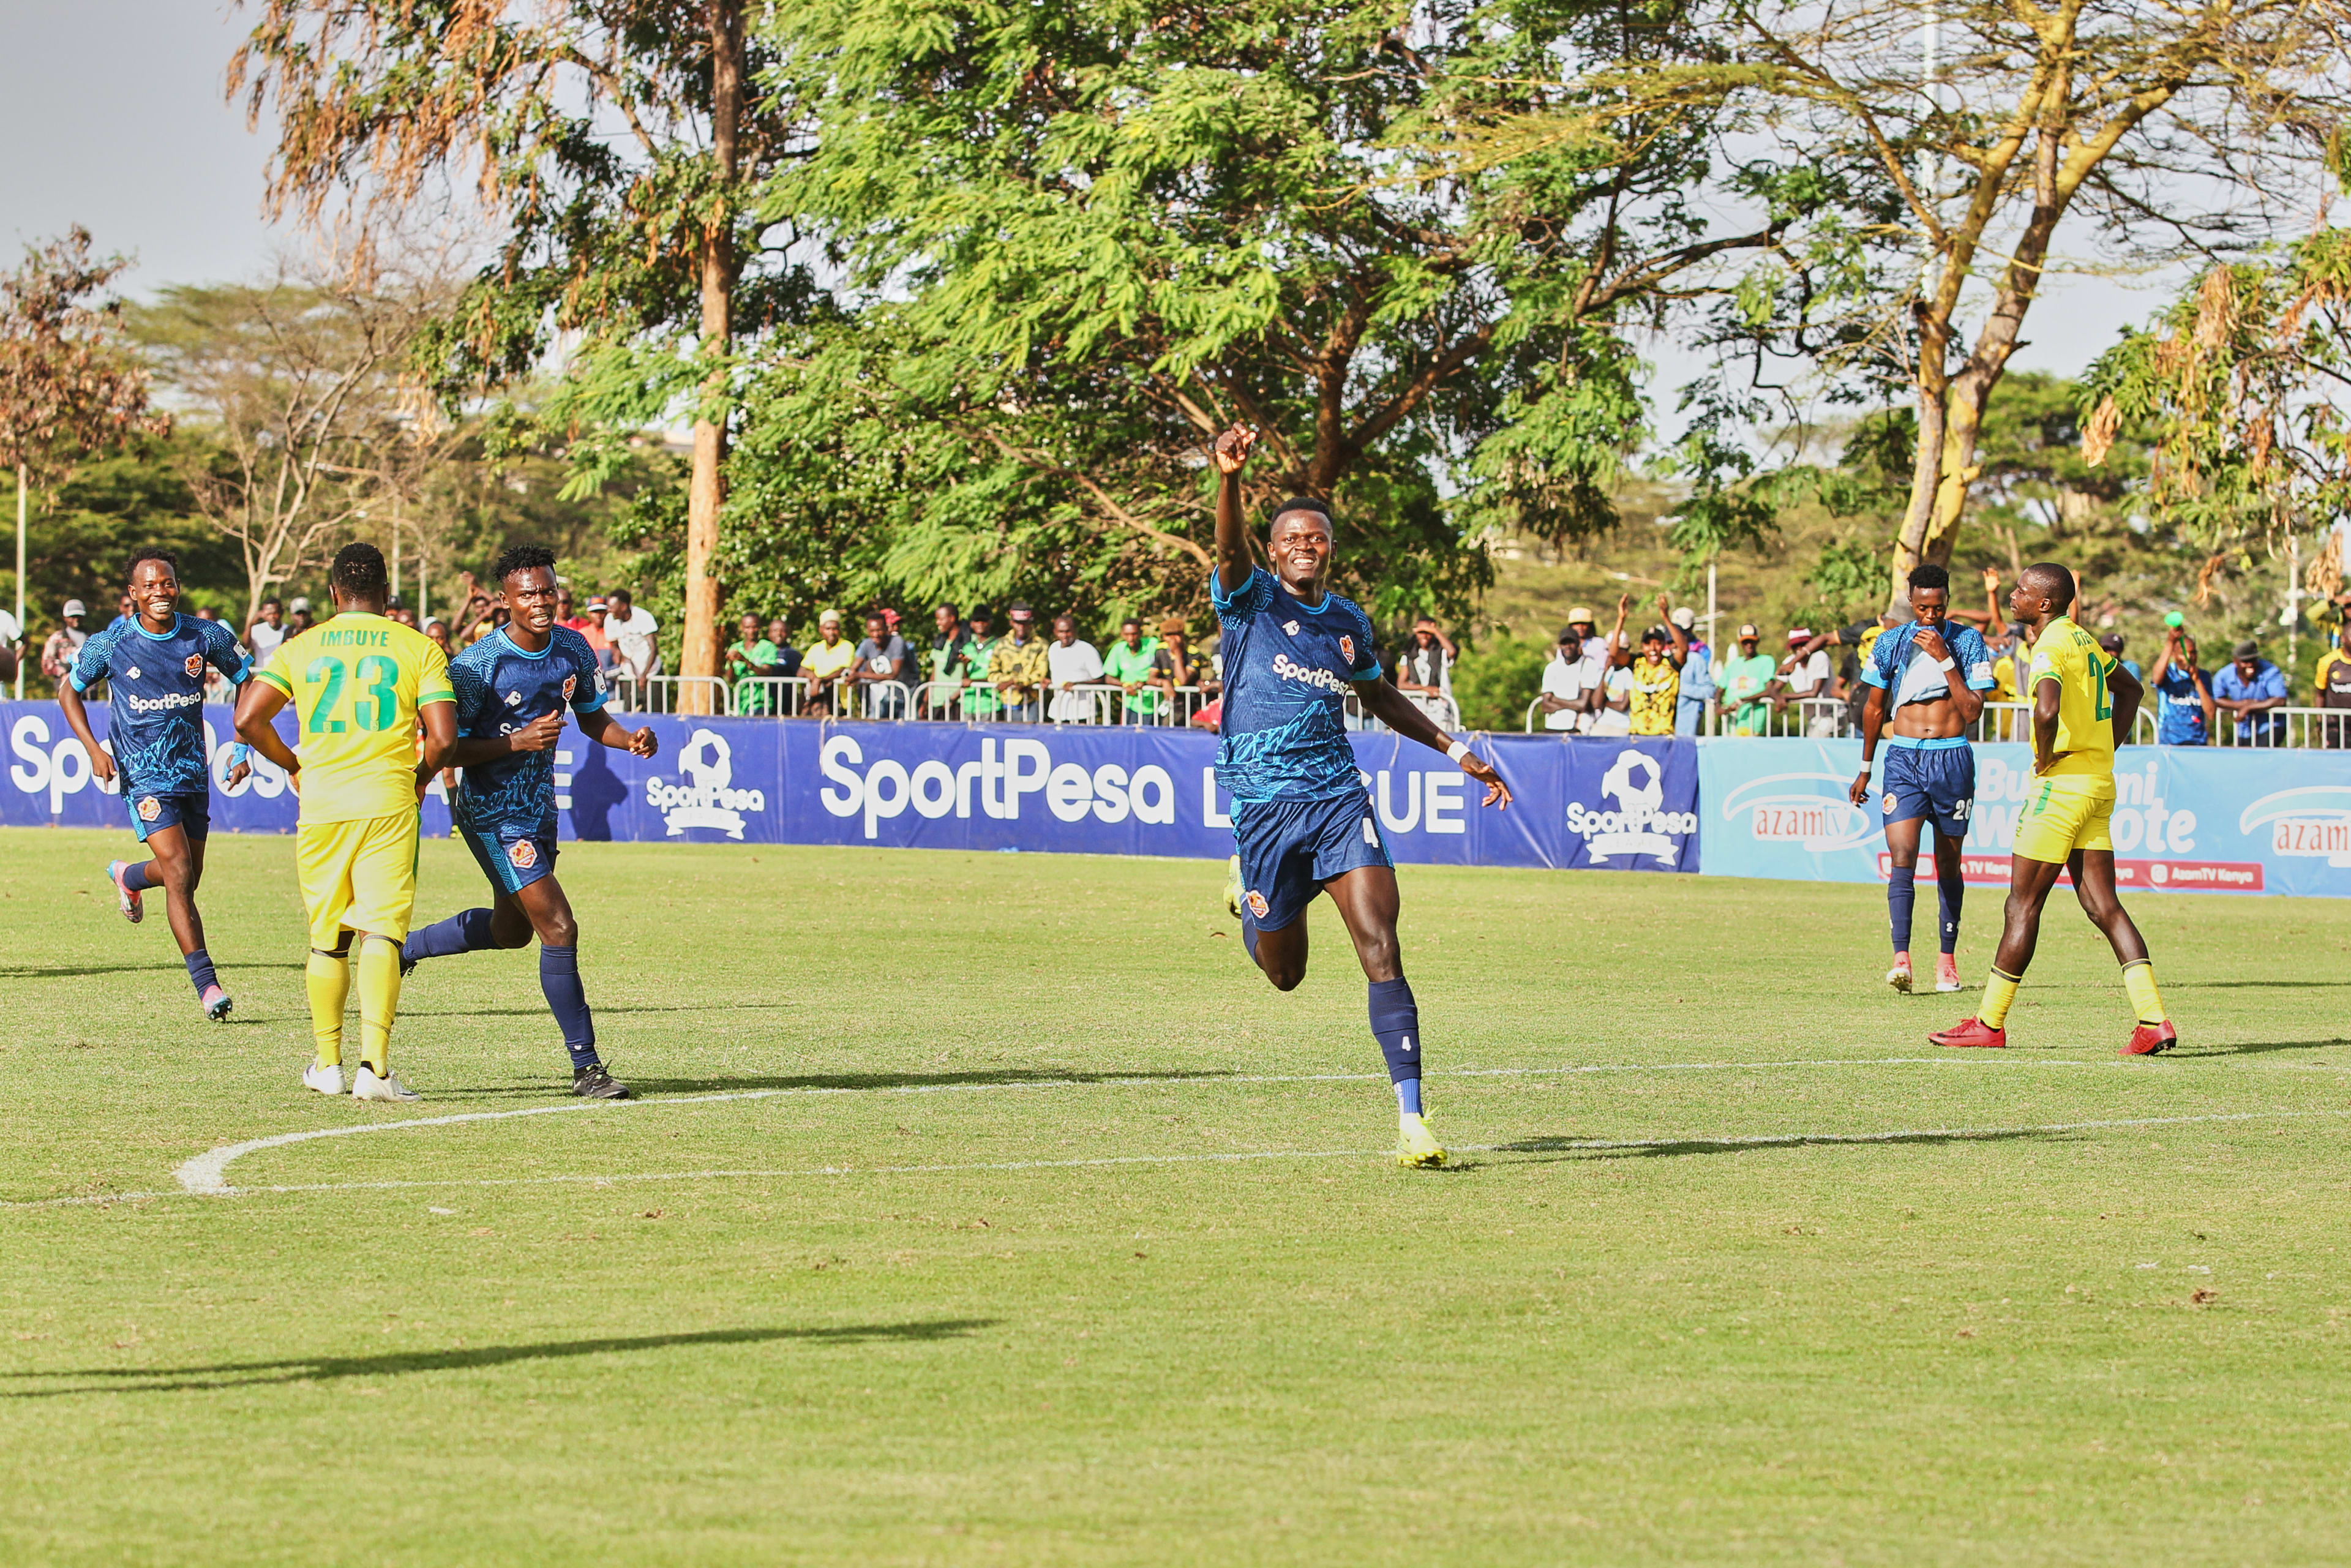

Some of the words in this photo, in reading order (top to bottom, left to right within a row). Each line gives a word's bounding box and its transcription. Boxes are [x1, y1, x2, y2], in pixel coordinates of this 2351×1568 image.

[320, 629, 389, 647] IMBUYE
[129, 691, 201, 714] SportPesa
[306, 655, 399, 733] 23
[2088, 651, 2112, 722] 2
[646, 776, 765, 814] SportPesa
[820, 735, 1175, 839] SportPesa
[1203, 767, 1466, 835] LUE
[1566, 801, 1698, 841] SportPesa
[1757, 803, 1850, 837] azamtv
[1952, 798, 1973, 820] 26
[2110, 797, 2197, 854] ote
[1362, 817, 1380, 849] 4
[2277, 823, 2350, 851] azam
[2218, 868, 2254, 885] Kenya
[1401, 1035, 1412, 1051] 4
